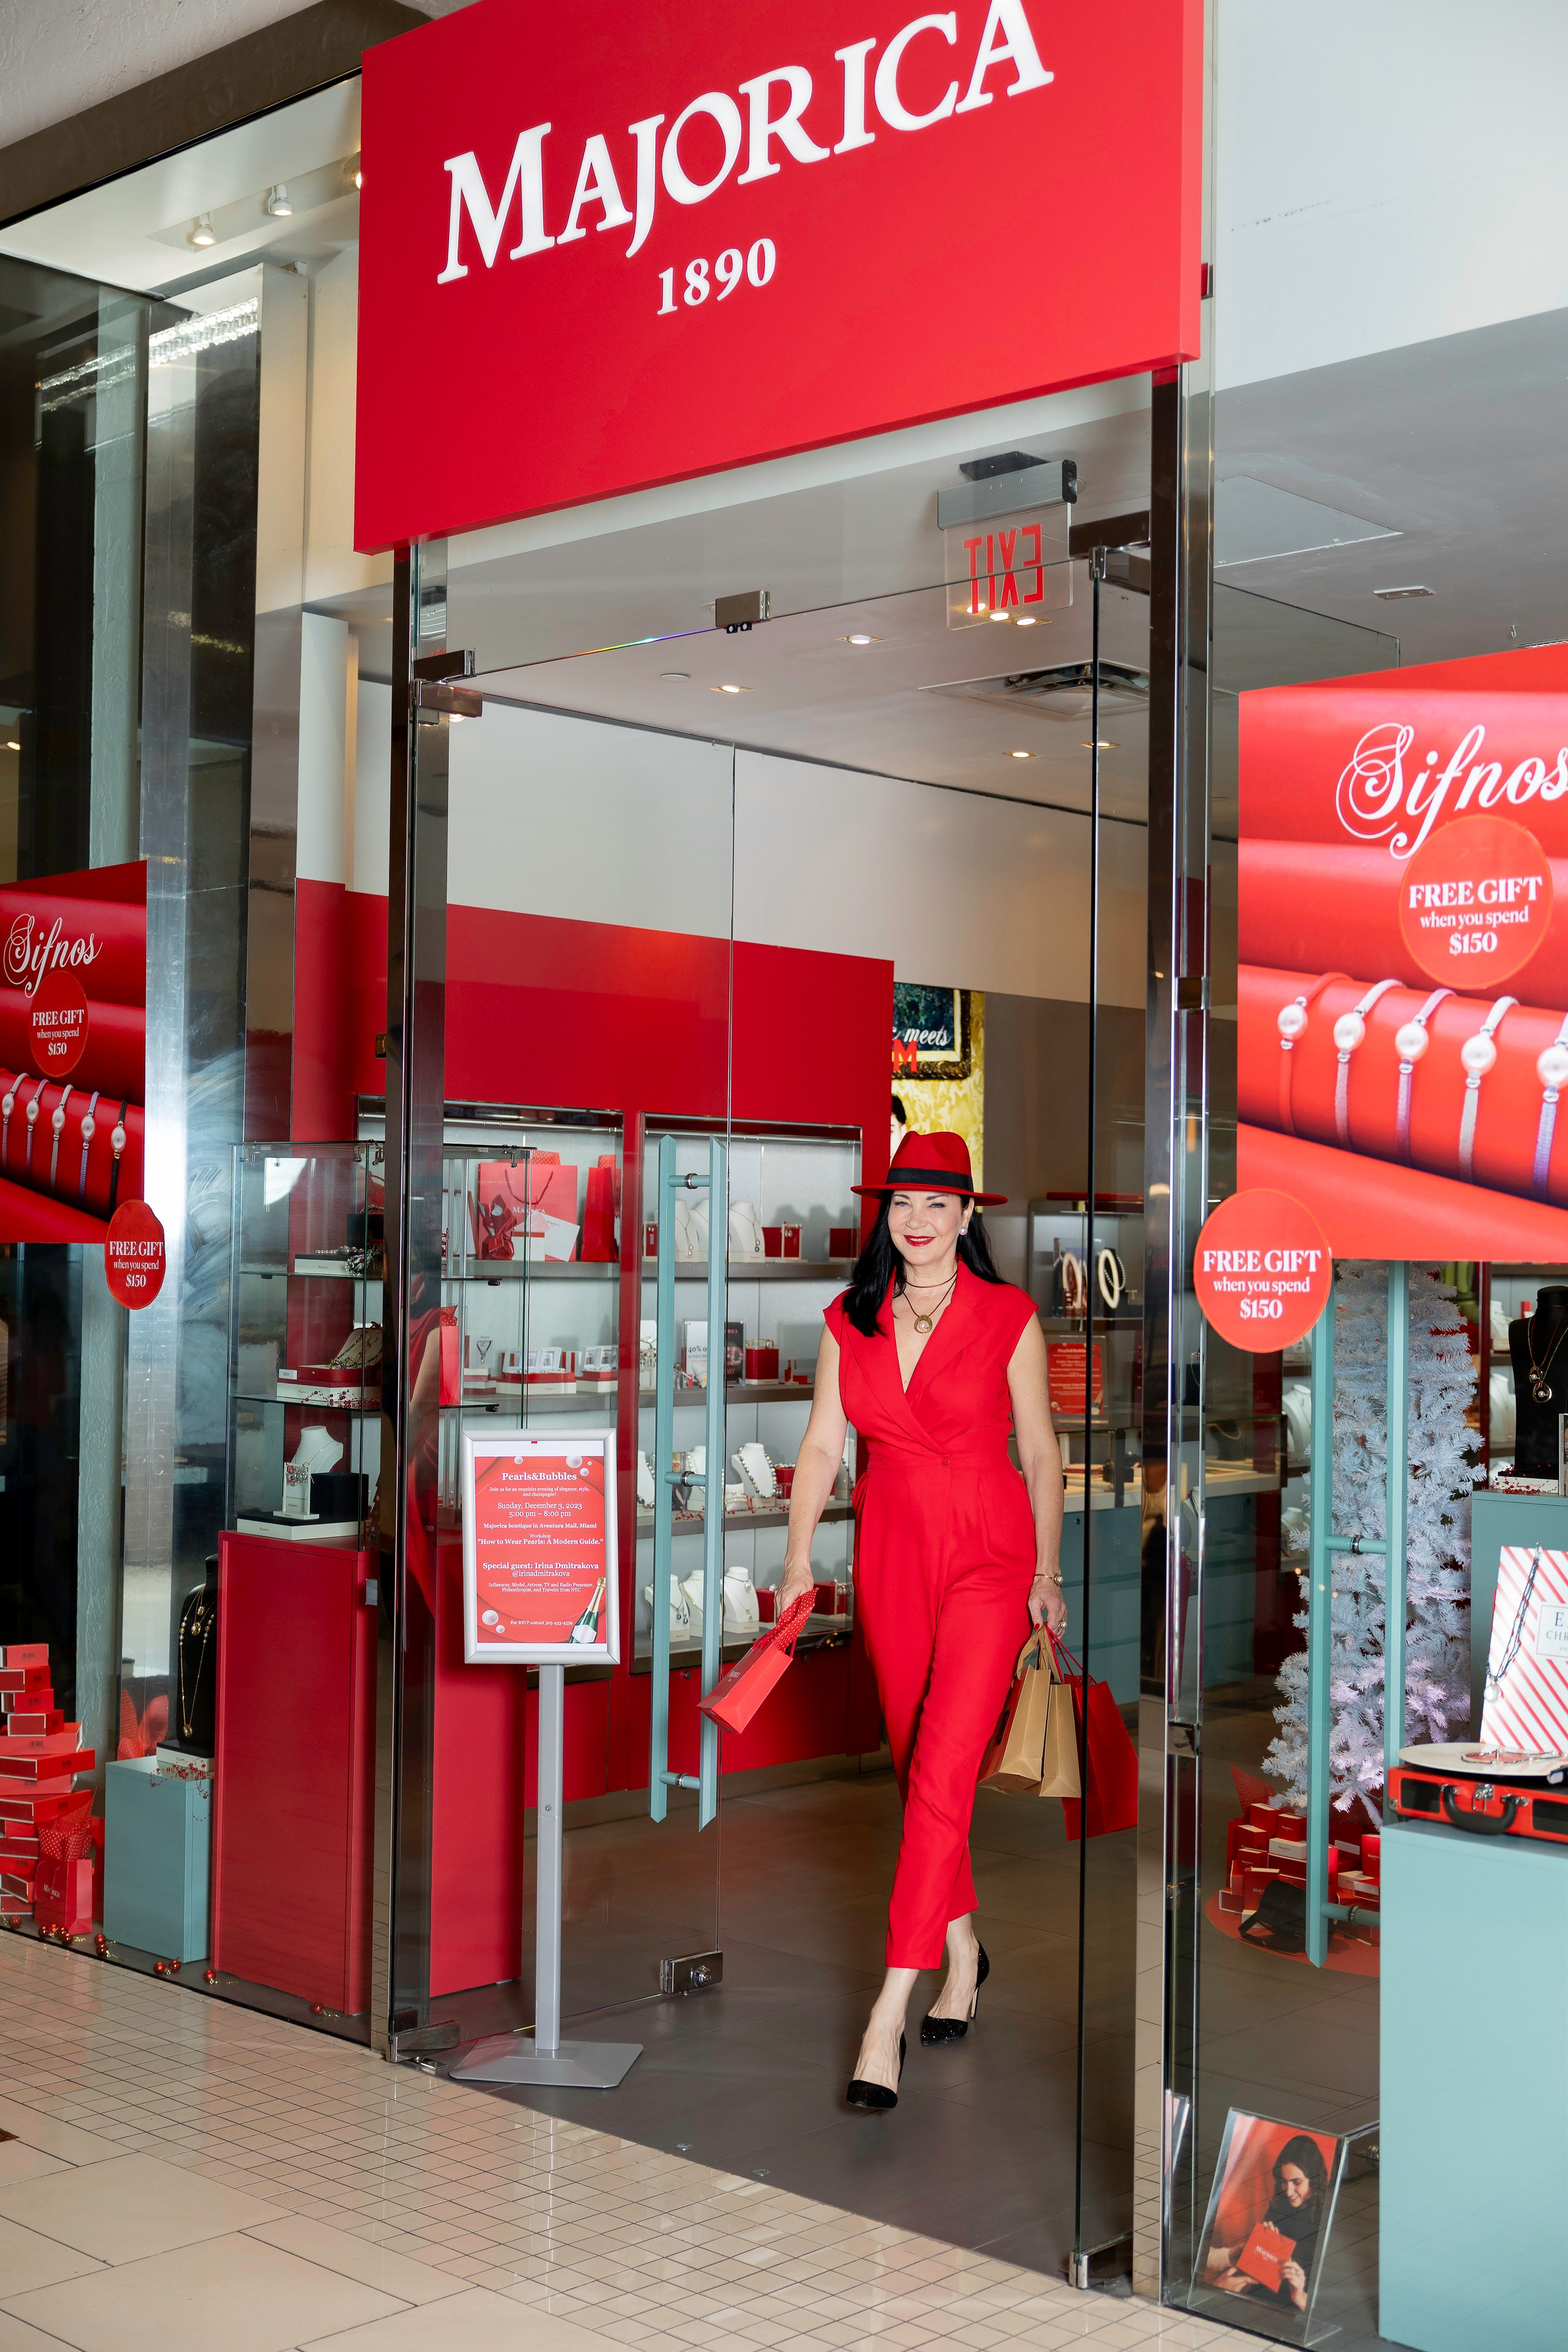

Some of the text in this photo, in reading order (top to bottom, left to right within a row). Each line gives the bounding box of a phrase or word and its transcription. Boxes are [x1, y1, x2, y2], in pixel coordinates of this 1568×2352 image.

[437, 0, 1054, 284] MAJORICA
[657, 238, 777, 315] 1890
[1335, 722, 1568, 860] Sifnos
[1409, 876, 1543, 908] FREE GIFT
[1420, 904, 1529, 930] when you spend
[1449, 931, 1498, 956] $150
[3, 913, 103, 998] Sifnos
[32, 1009, 85, 1027] FREE GIFT
[37, 1027, 80, 1041] when you spend
[903, 1025, 952, 1046] meets
[48, 1041, 67, 1057] $150
[110, 1241, 164, 1256] FREE GIFT
[114, 1258, 159, 1272] when you spend
[1203, 1250, 1322, 1272] FREE GIFT
[126, 1273, 146, 1288] $150
[1213, 1276, 1310, 1296] when you spend
[1240, 1298, 1283, 1320] $150
[502, 1472, 578, 1480] Pearls&Bubbles
